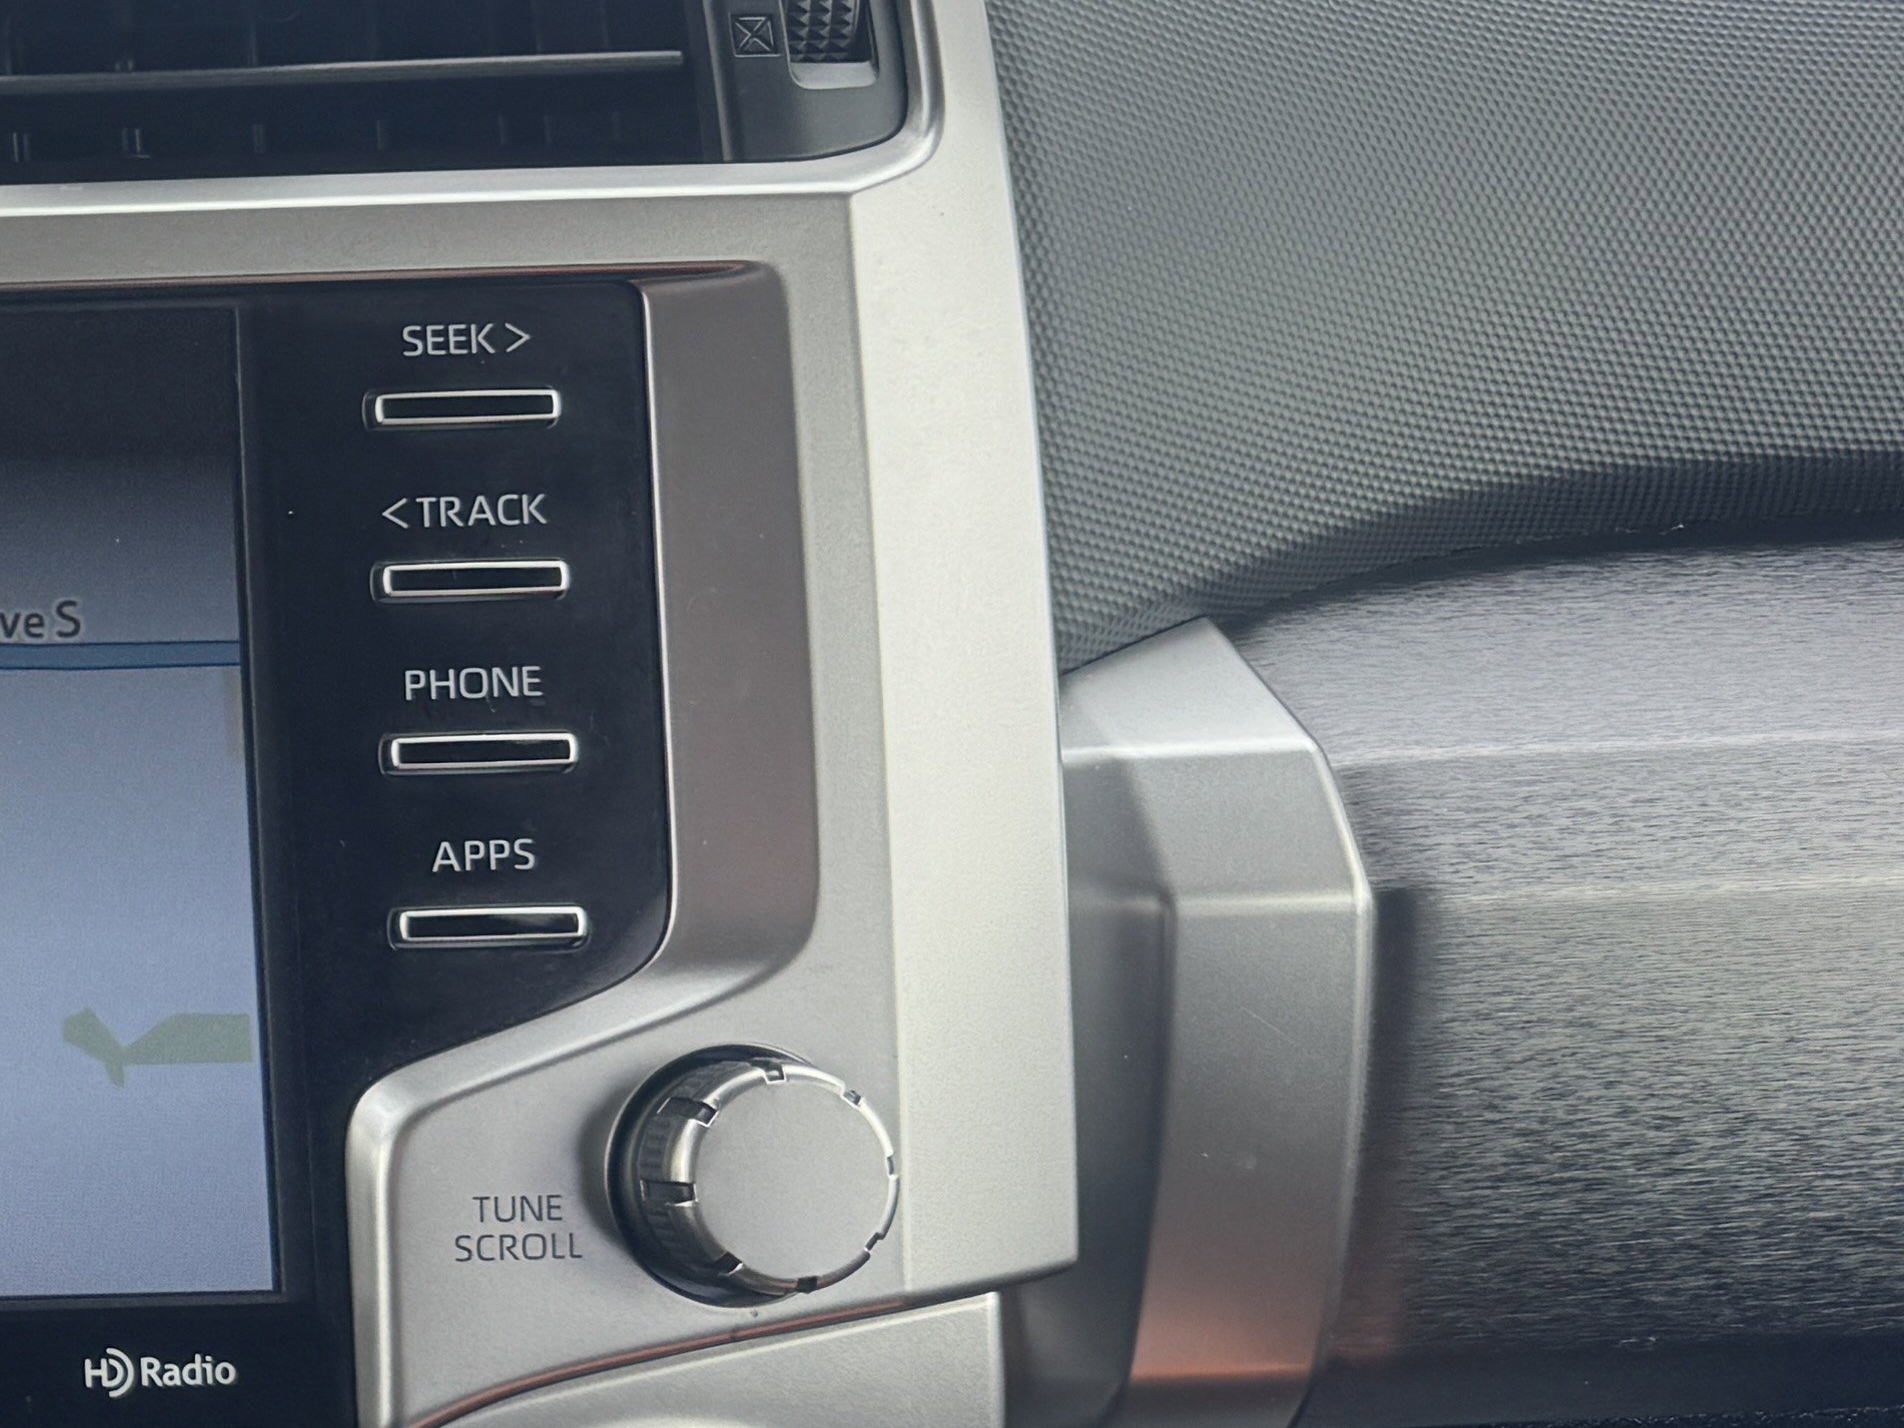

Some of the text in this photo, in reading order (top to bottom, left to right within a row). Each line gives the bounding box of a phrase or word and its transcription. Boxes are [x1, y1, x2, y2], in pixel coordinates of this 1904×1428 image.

[55, 601, 82, 637] S
[404, 665, 544, 701] PHONE
[431, 838, 536, 872] APPS
[472, 1194, 563, 1223] TUNE
[454, 1232, 583, 1262] SCROLL
[140, 1354, 237, 1388] Radio
